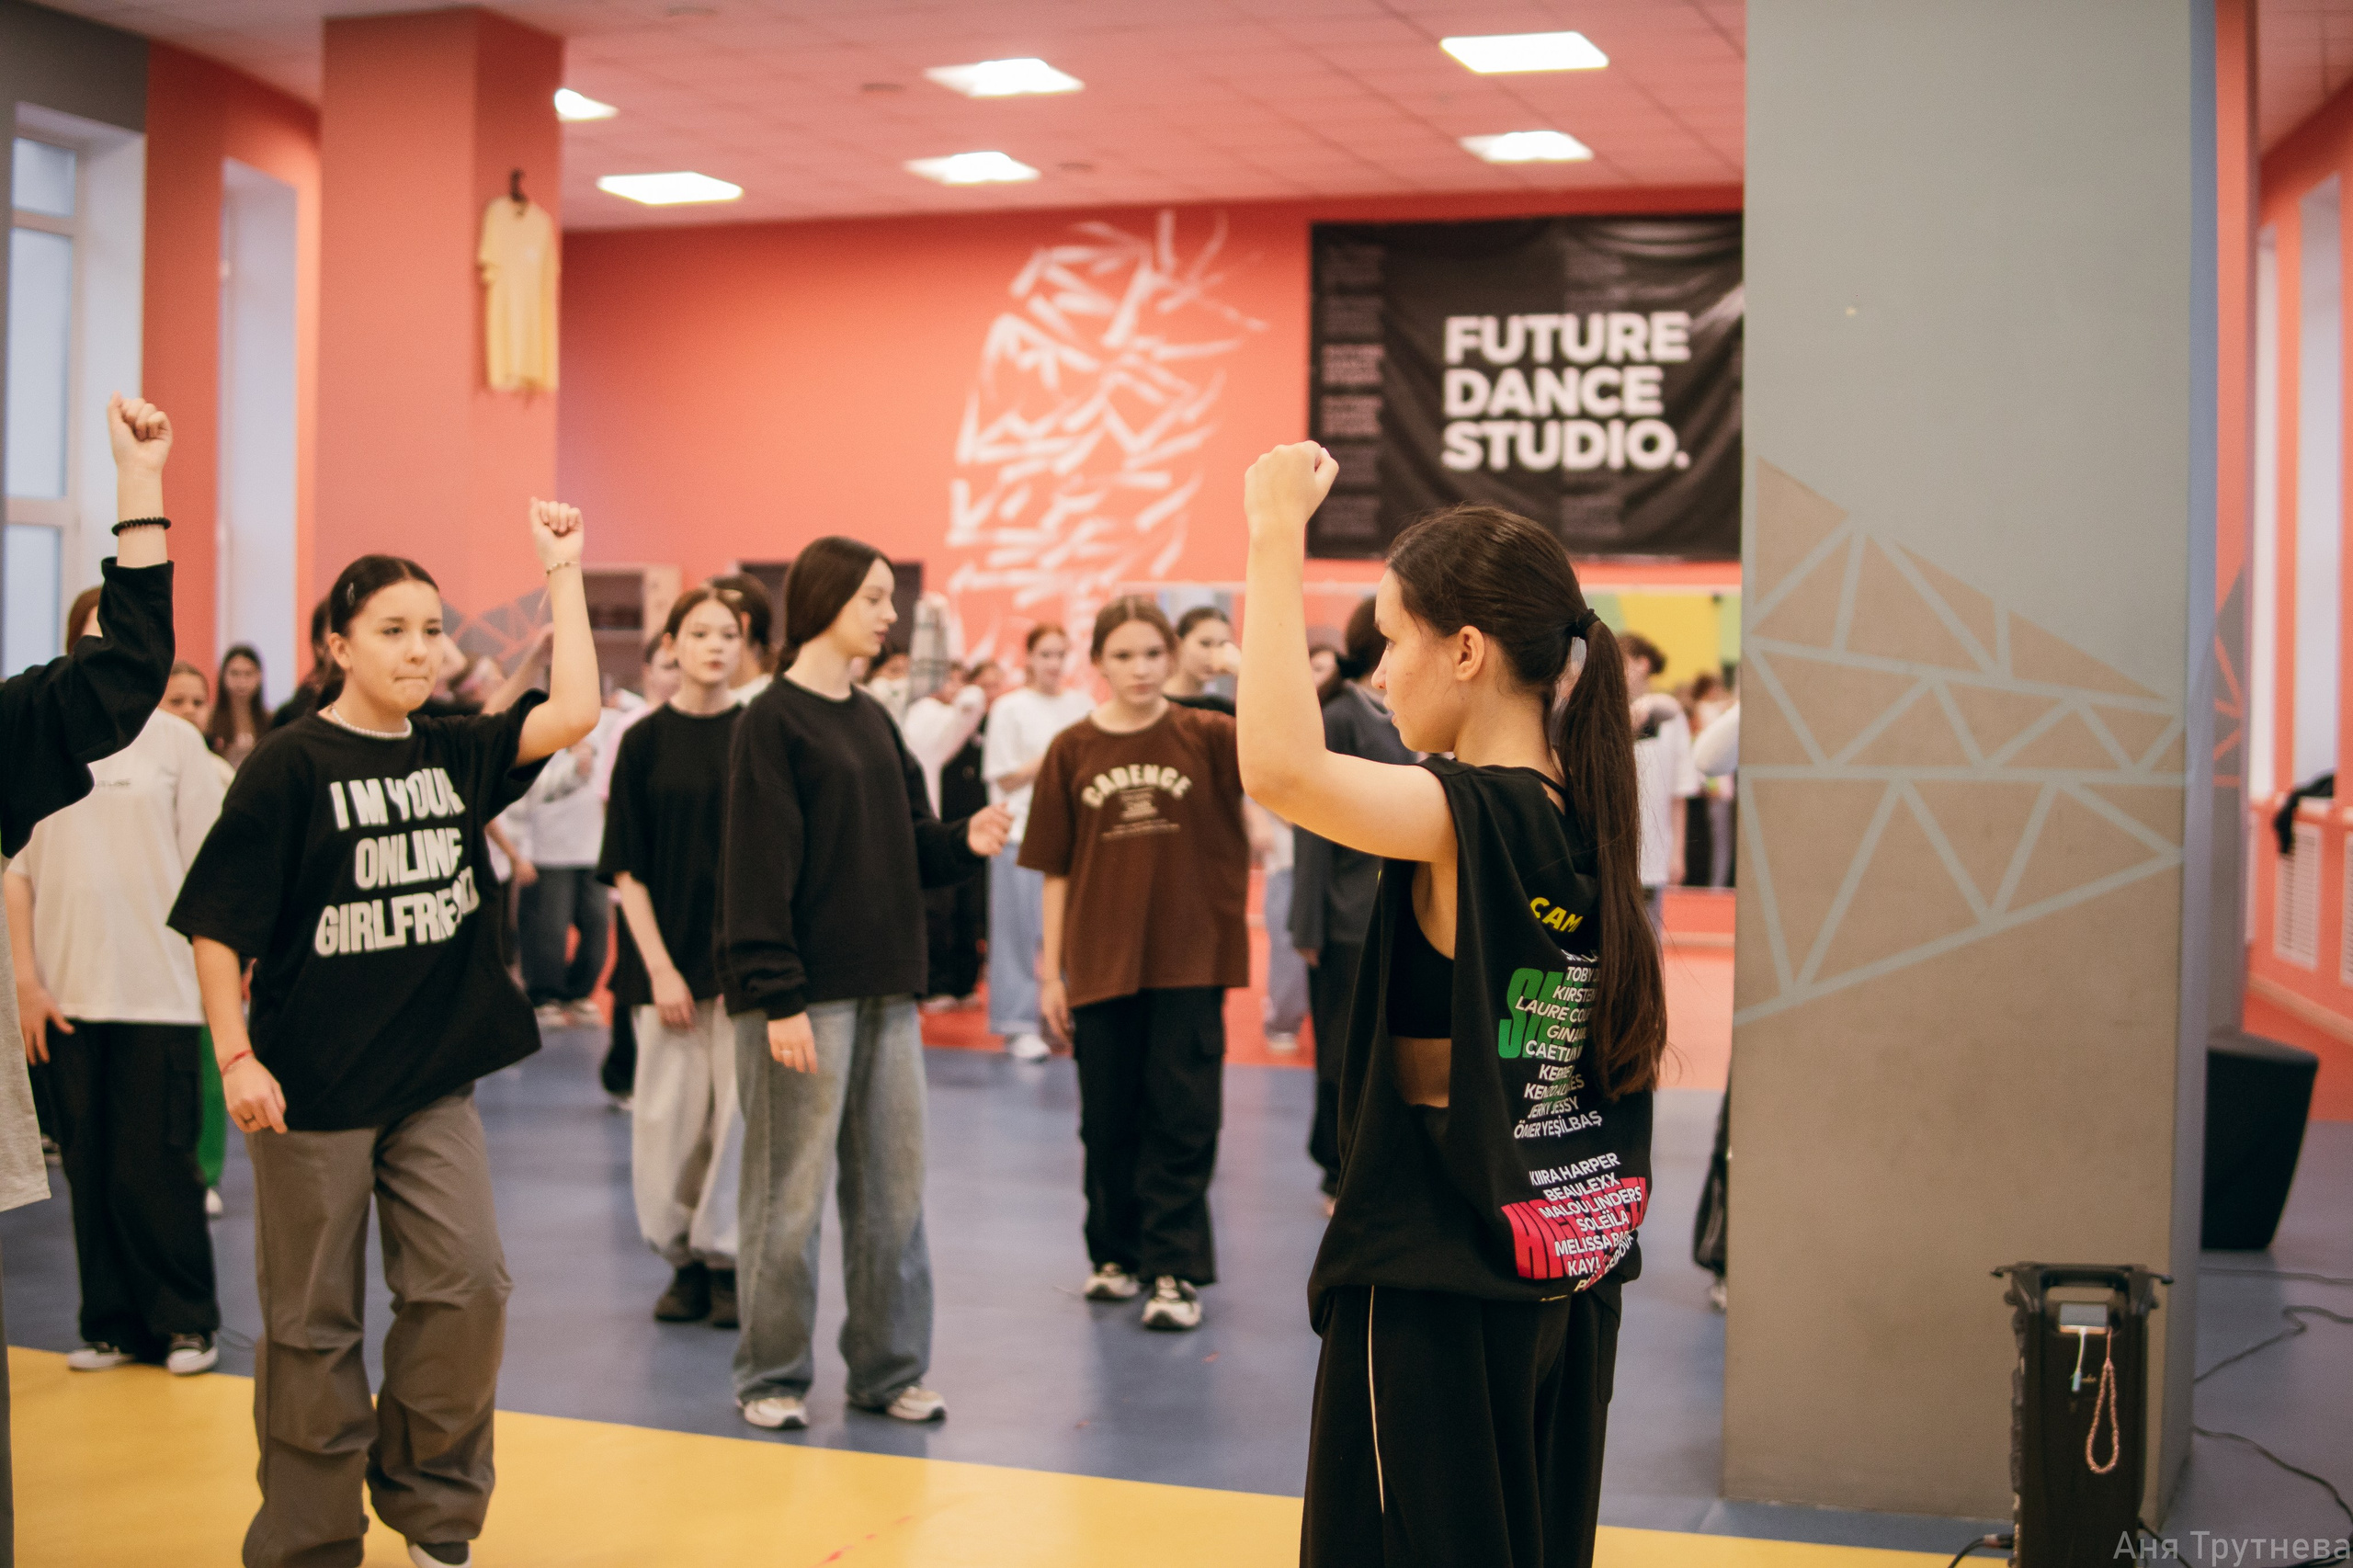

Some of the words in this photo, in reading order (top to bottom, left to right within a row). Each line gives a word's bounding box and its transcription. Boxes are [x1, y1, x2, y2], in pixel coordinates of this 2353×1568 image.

[1443, 312, 1692, 365] FUTURE
[1443, 366, 1665, 418] DANCE
[1441, 418, 1691, 472] STUDIO.
[1565, 966, 1595, 983] TOBY
[1515, 995, 1571, 1021] LAURE
[1551, 1096, 1580, 1115] JESSY
[1513, 1119, 1541, 1139] ÖMER
[1529, 1169, 1563, 1186] KIIRA
[1562, 1153, 1621, 1180] HARPER
[1542, 1172, 1620, 1202] BEAULEXX
[1538, 1199, 1592, 1219] MALOU
[1589, 1186, 1643, 1212] LINDERS
[1554, 1233, 1613, 1257] MELISSA
